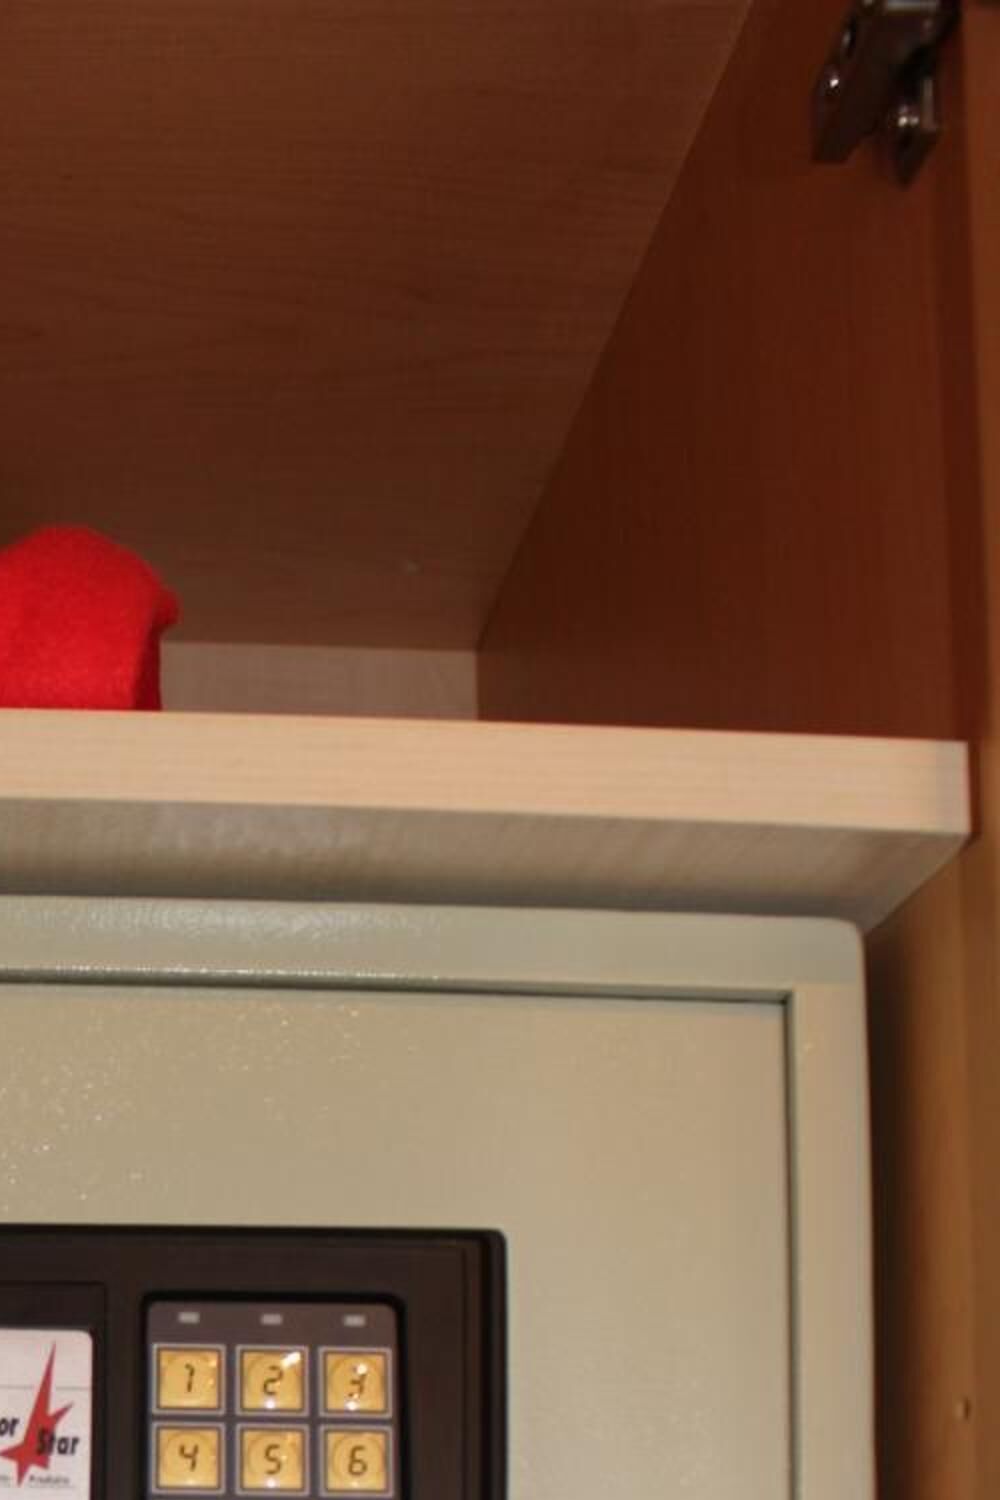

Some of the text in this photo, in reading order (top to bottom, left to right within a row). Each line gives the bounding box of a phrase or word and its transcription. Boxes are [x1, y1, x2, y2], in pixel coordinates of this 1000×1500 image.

[184, 1363, 196, 1393] 1
[263, 1366, 284, 1397] 2
[36, 1427, 80, 1456] Star
[178, 1443, 368, 1477] 4 5 6
